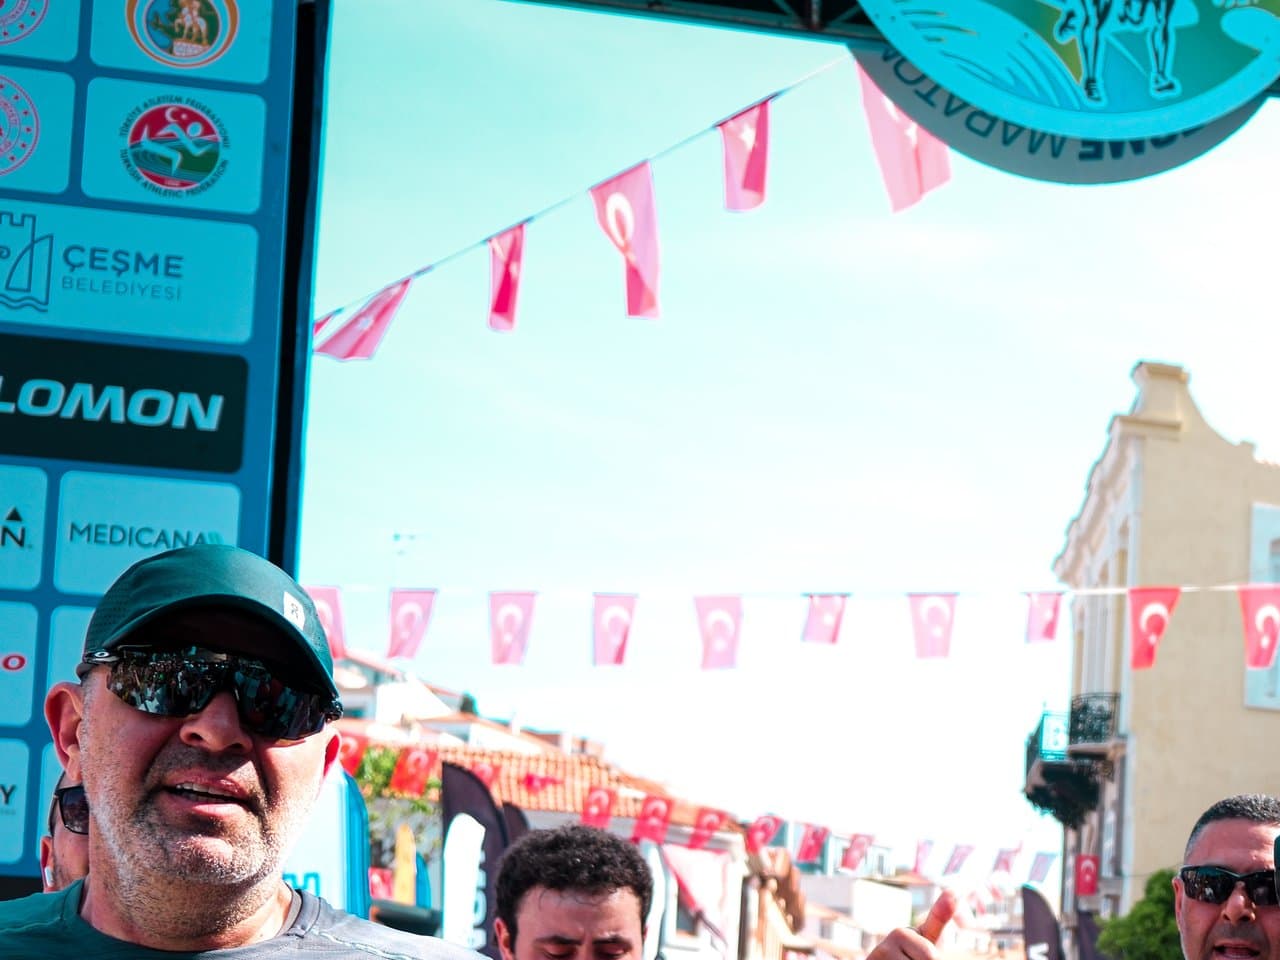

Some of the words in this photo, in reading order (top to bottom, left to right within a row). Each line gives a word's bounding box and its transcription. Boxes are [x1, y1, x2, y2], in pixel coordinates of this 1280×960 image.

[62, 245, 184, 279] ÇEŞME
[62, 276, 181, 301] BELEDİYESİ
[69, 522, 211, 550] MEDICANA
